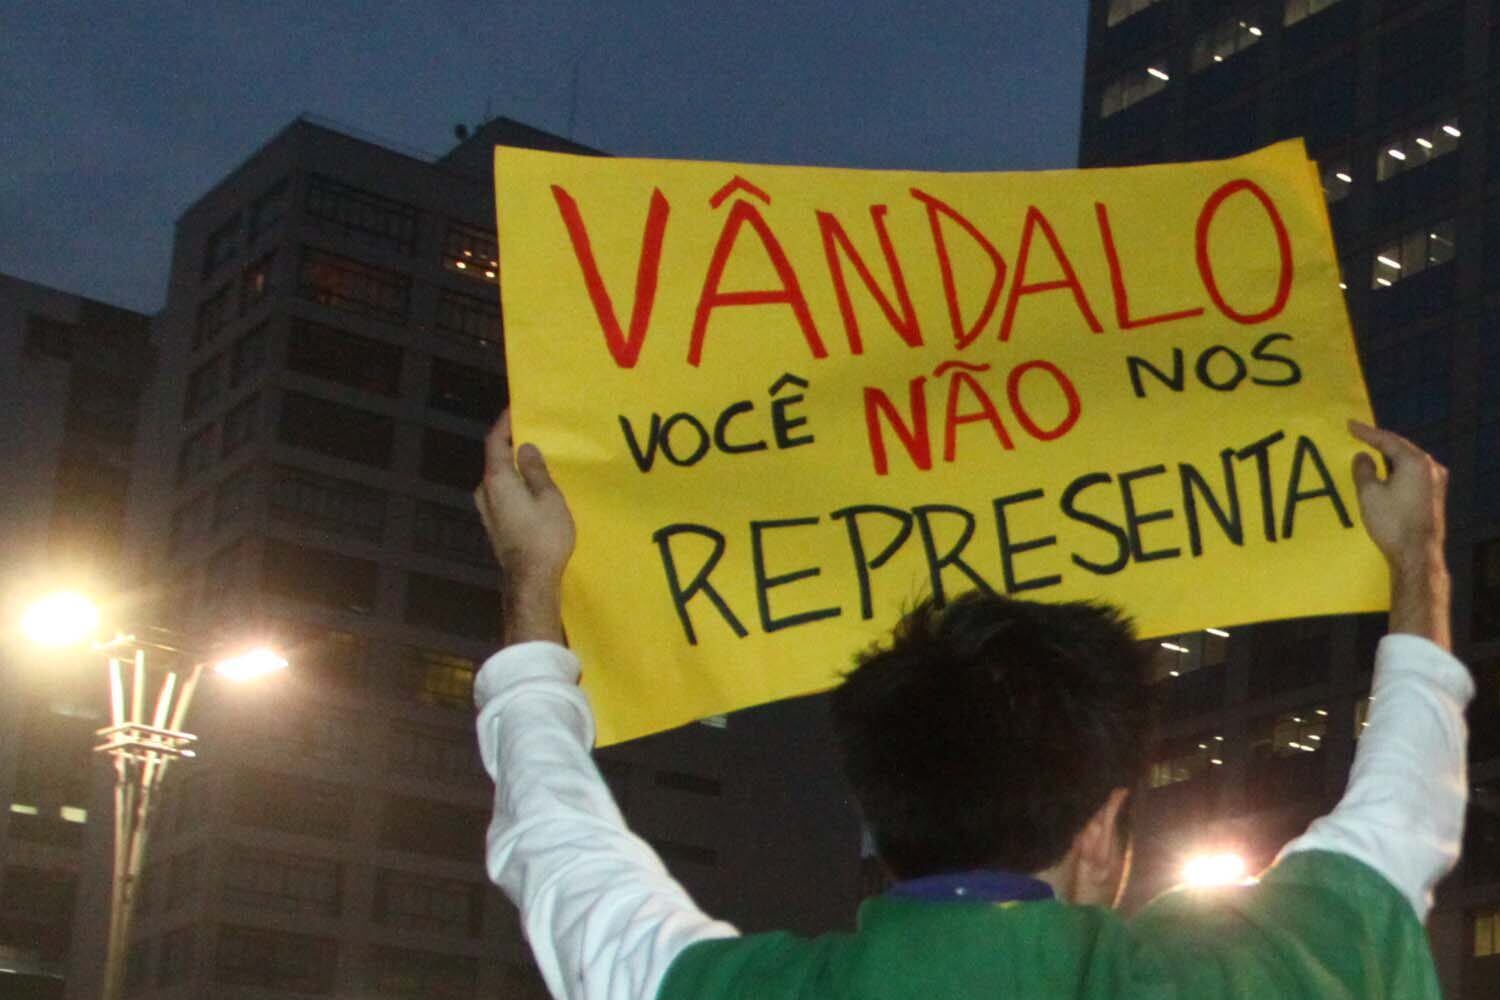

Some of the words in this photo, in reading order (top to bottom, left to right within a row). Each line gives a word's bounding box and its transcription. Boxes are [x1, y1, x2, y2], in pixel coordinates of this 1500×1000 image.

[551, 175, 1294, 368] VÂNDALO
[619, 372, 816, 472] VOCÊ
[863, 359, 1081, 476] NÃO
[1127, 332, 1302, 398] NOS
[652, 430, 1354, 646] REPRESENTA
